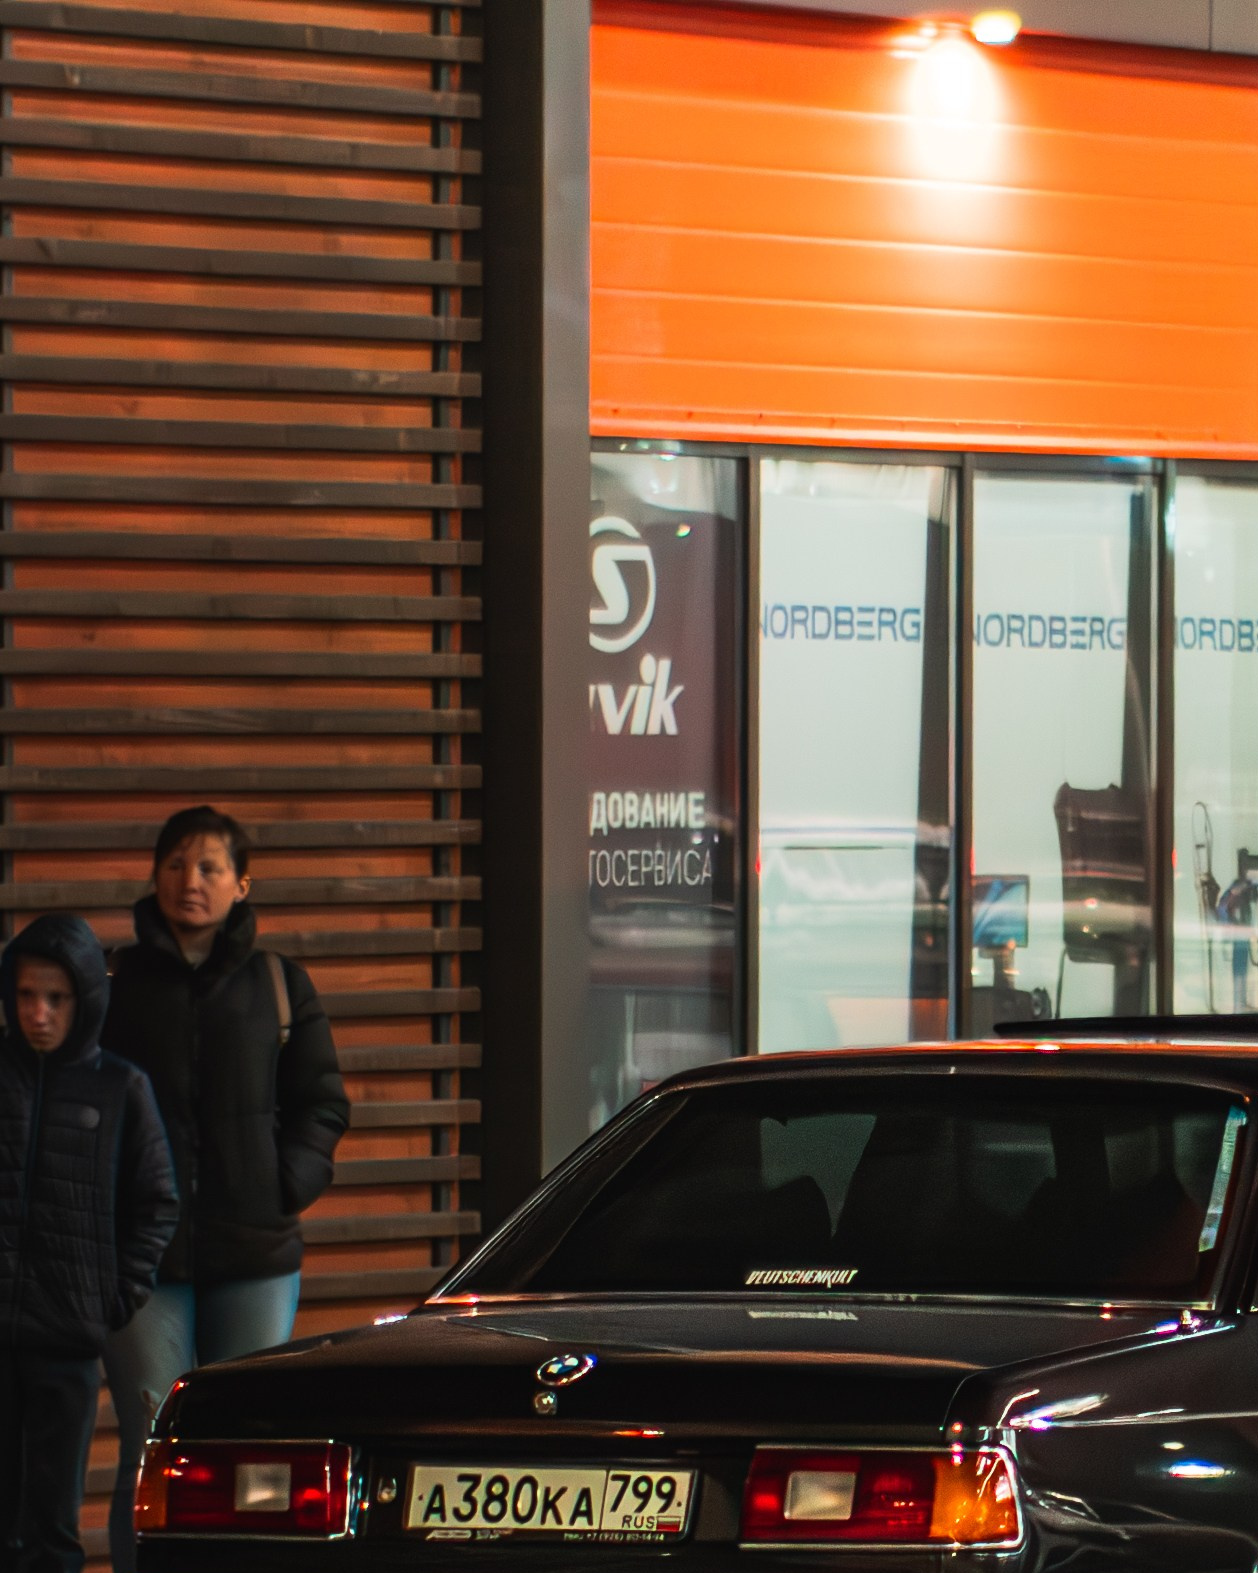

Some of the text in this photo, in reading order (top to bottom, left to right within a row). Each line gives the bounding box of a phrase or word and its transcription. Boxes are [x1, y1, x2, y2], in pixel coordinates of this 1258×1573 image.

[589, 653, 684, 736] vik
[590, 790, 706, 836] ДОВАНИЕ
[609, 1474, 677, 1514] 799
[621, 1515, 656, 1530] RUS
